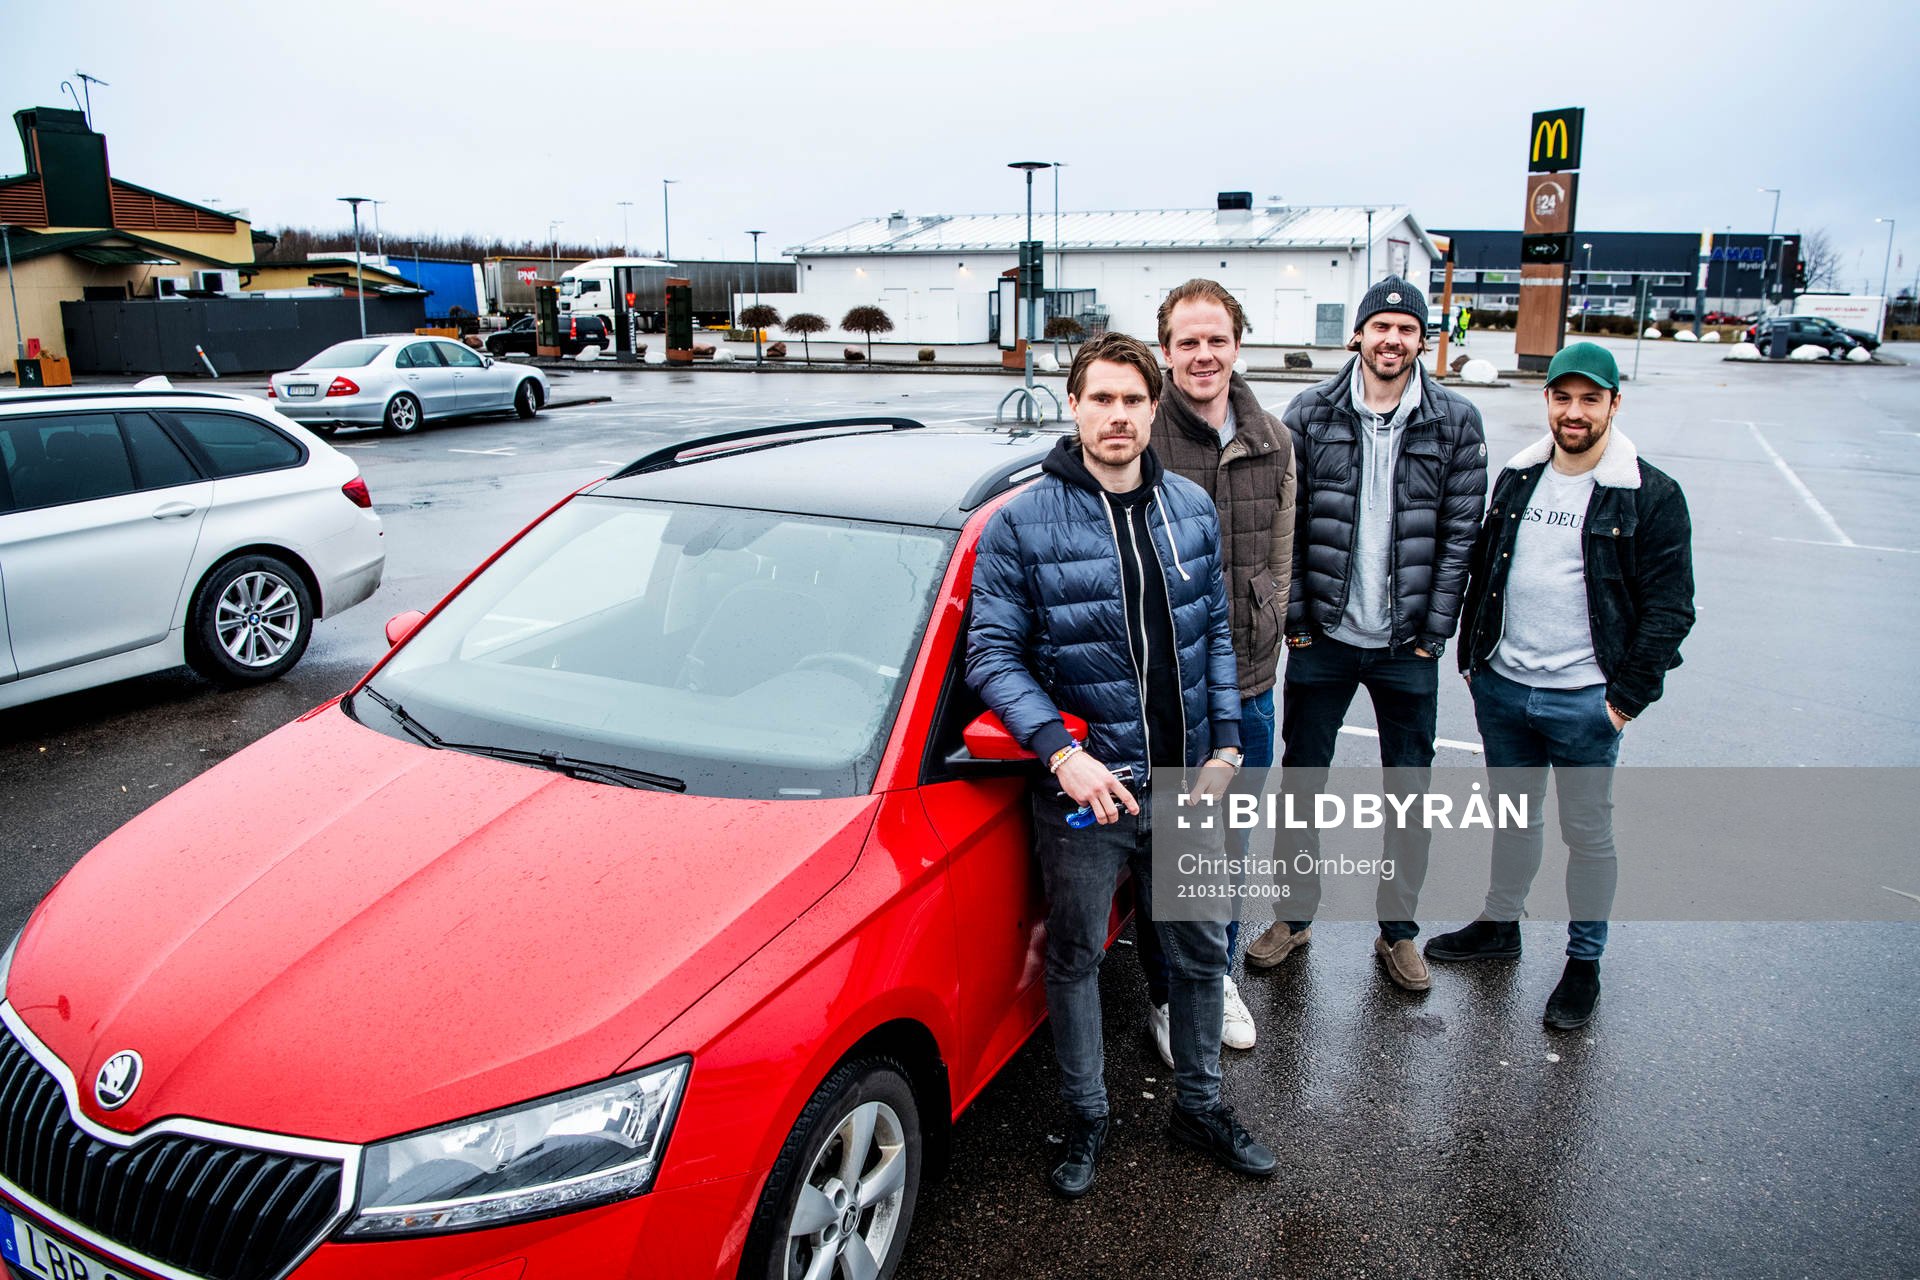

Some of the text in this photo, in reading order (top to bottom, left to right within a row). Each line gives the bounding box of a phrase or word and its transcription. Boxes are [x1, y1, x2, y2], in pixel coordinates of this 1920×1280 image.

[1540, 195, 1556, 209] 24
[1712, 247, 1764, 260] AMAB
[1522, 507, 1584, 528] ES DEU
[5, 1238, 13, 1251] S
